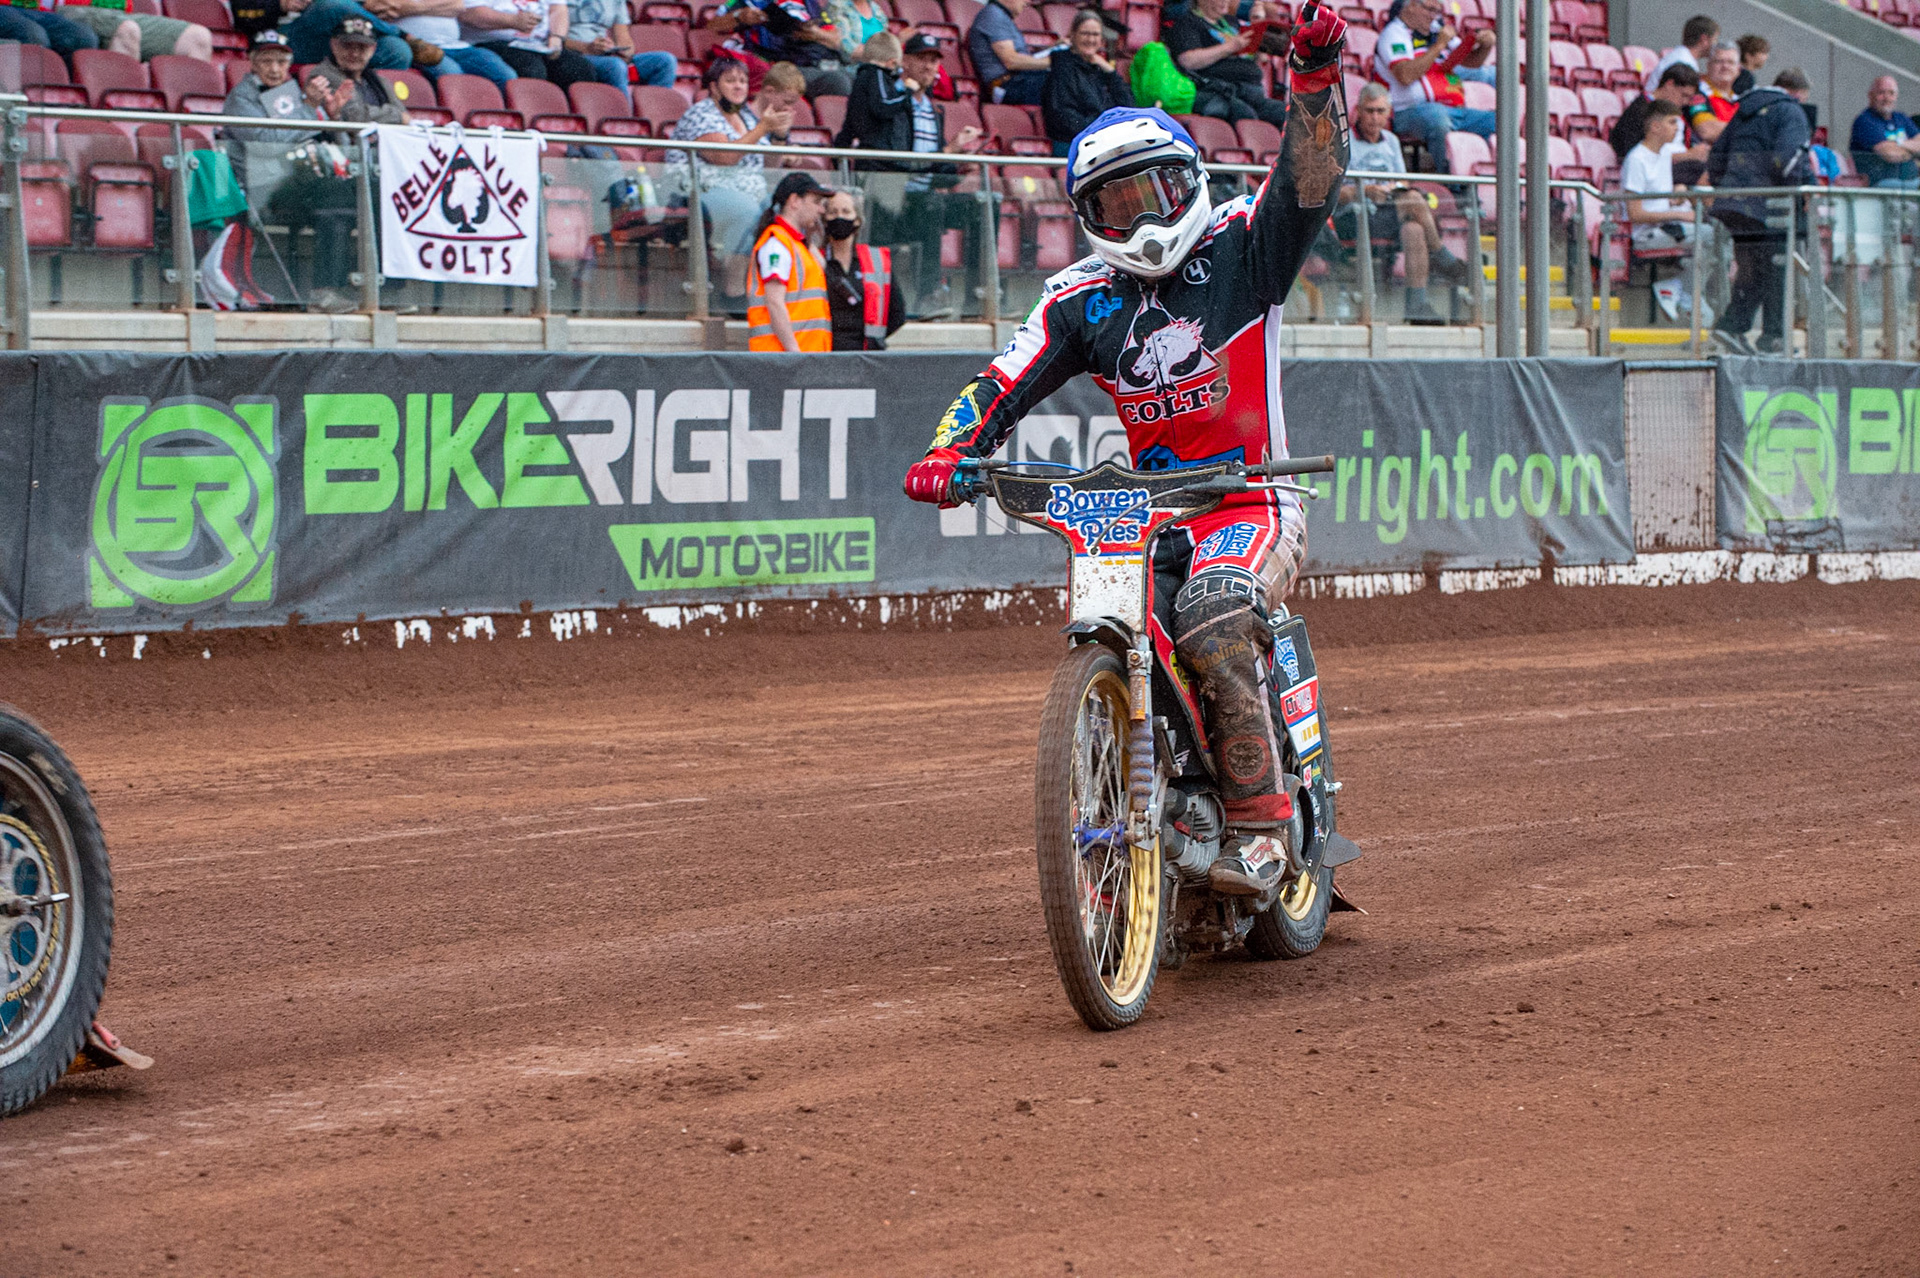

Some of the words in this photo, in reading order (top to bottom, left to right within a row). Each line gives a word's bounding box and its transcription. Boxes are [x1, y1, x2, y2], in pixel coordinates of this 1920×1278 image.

[391, 142, 448, 223] BELLE
[484, 143, 529, 218] VUE
[418, 241, 511, 275] COLTS
[1121, 374, 1231, 424] COLTS
[304, 388, 877, 515] BIKERIGHT
[1047, 485, 1148, 521] Bowen
[1080, 518, 1140, 547] Pies
[1223, 523, 1258, 556] owen
[640, 531, 871, 580] MOTORBIKE
